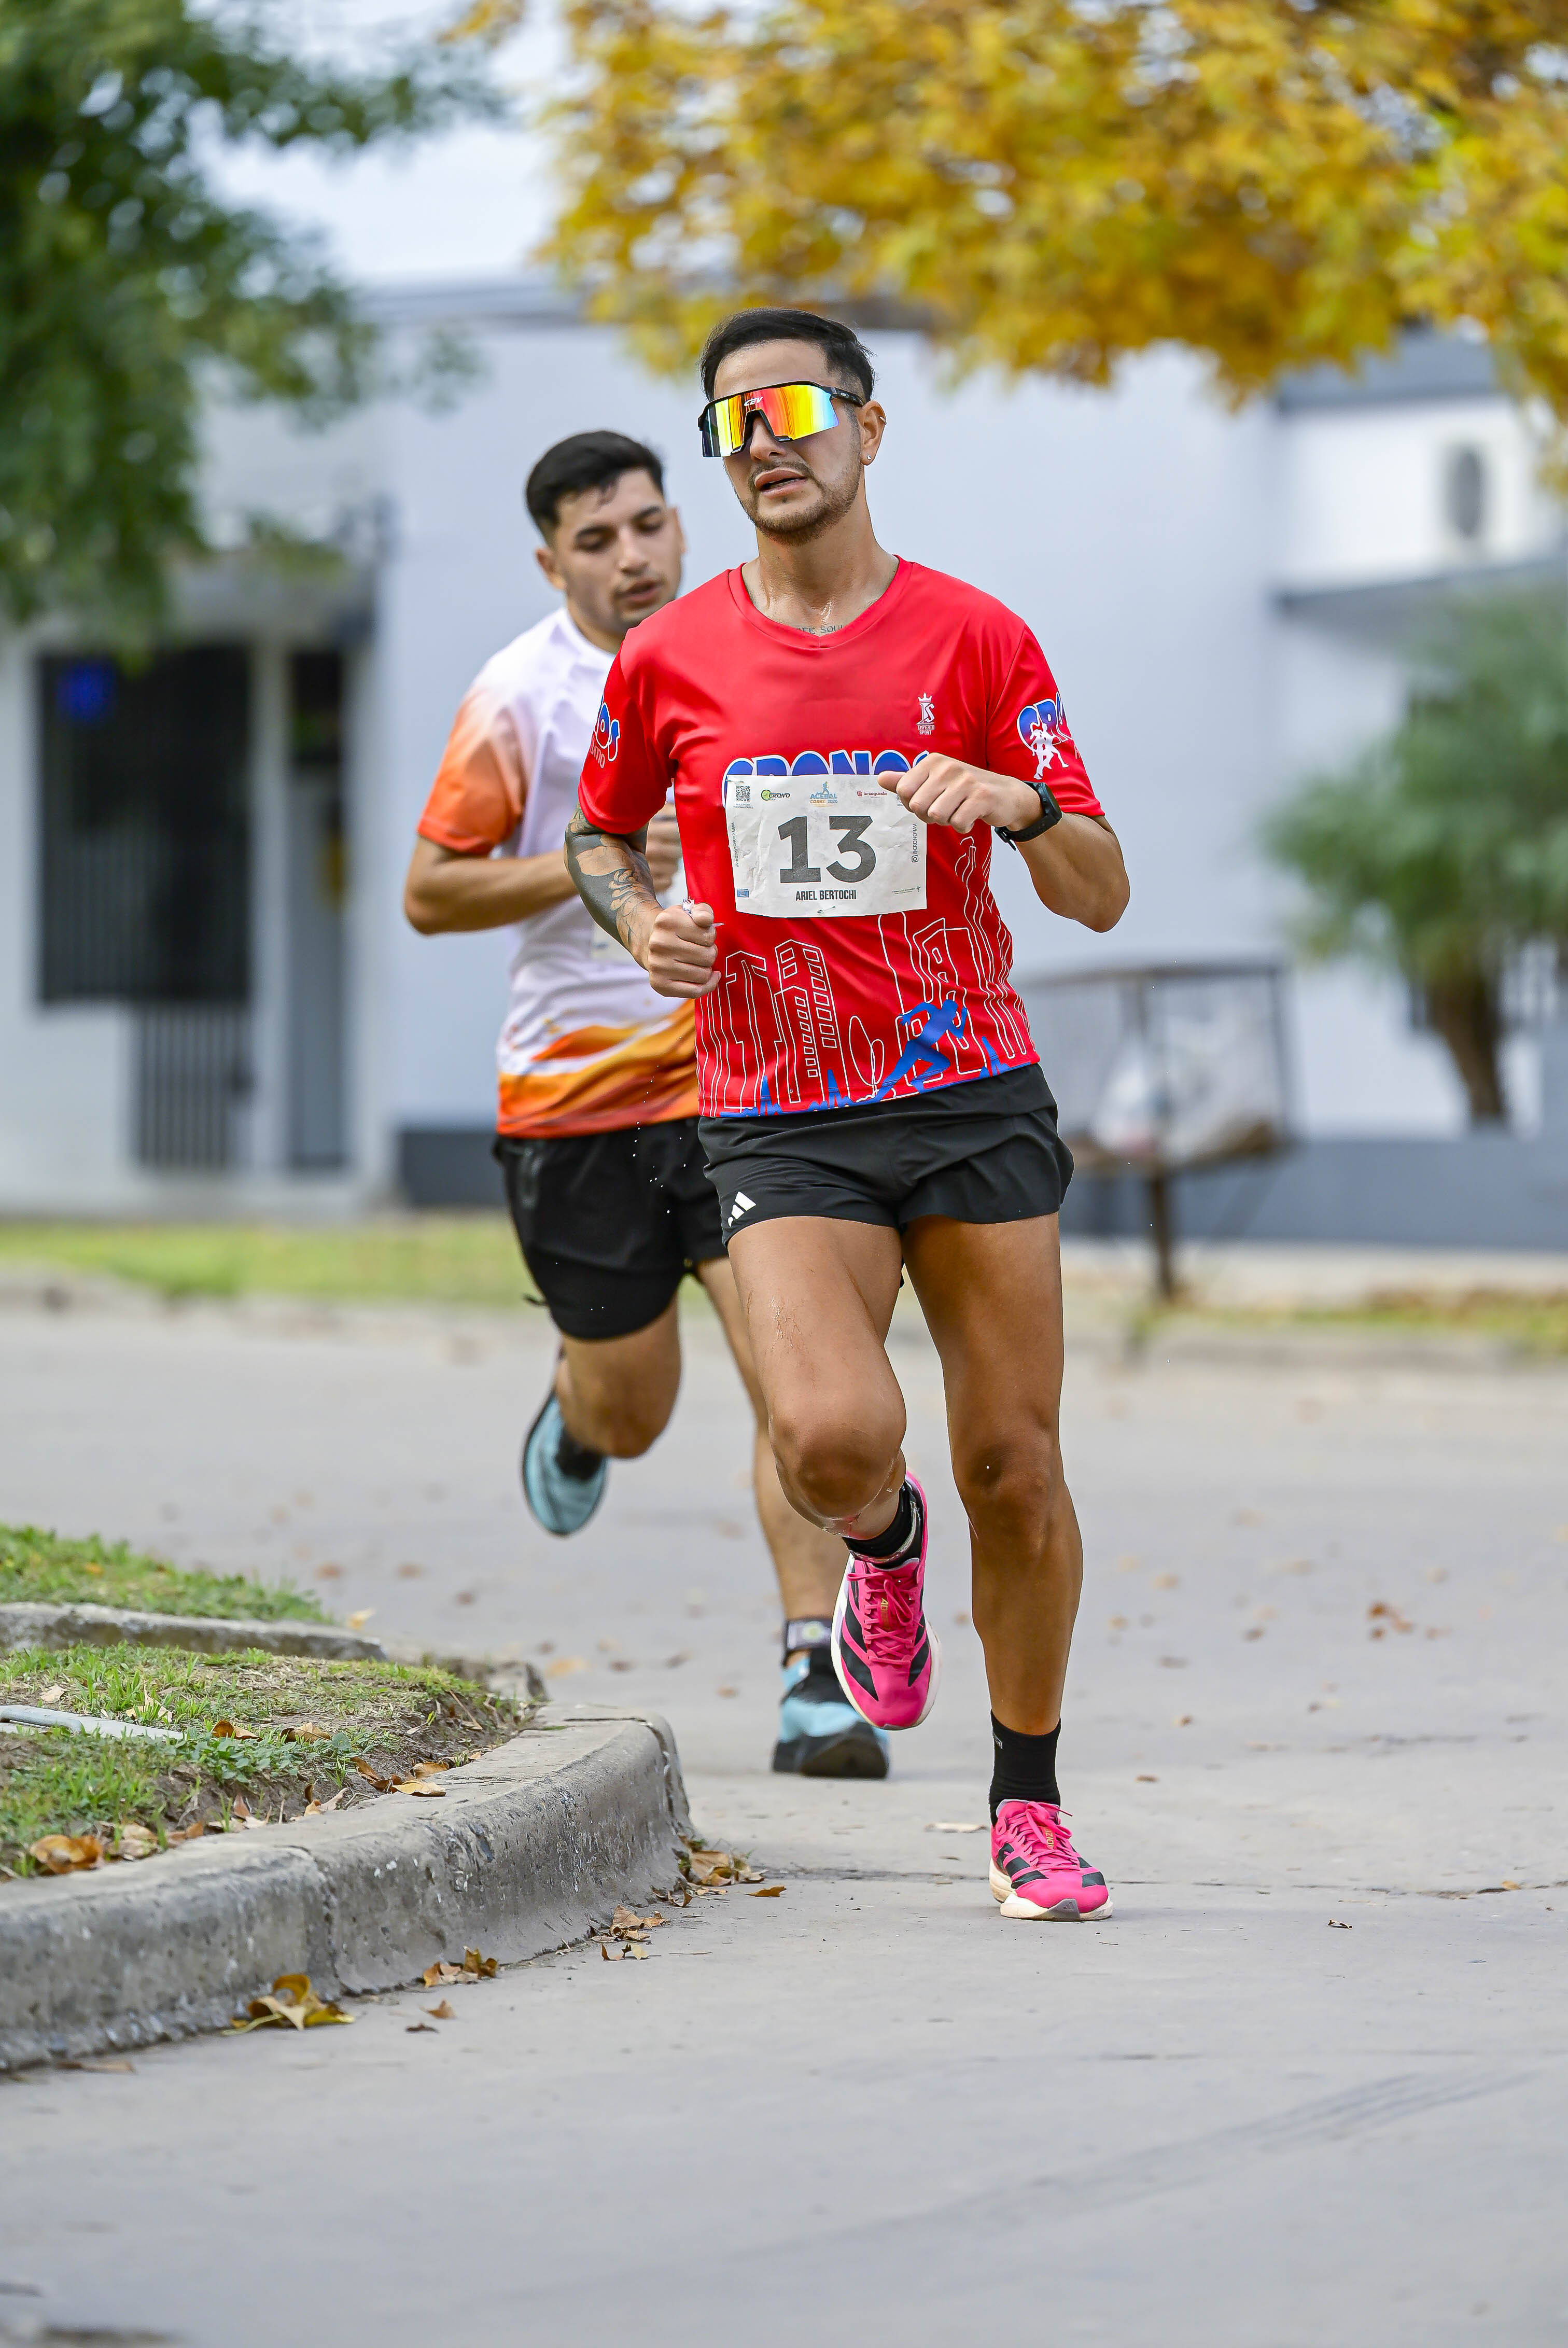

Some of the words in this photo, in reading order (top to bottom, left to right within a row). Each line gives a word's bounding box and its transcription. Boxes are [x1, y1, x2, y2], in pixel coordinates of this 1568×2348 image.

[778, 816, 876, 883] 13
[795, 890, 818, 901] ARIEL
[819, 889, 857, 900] BERTOCHI
